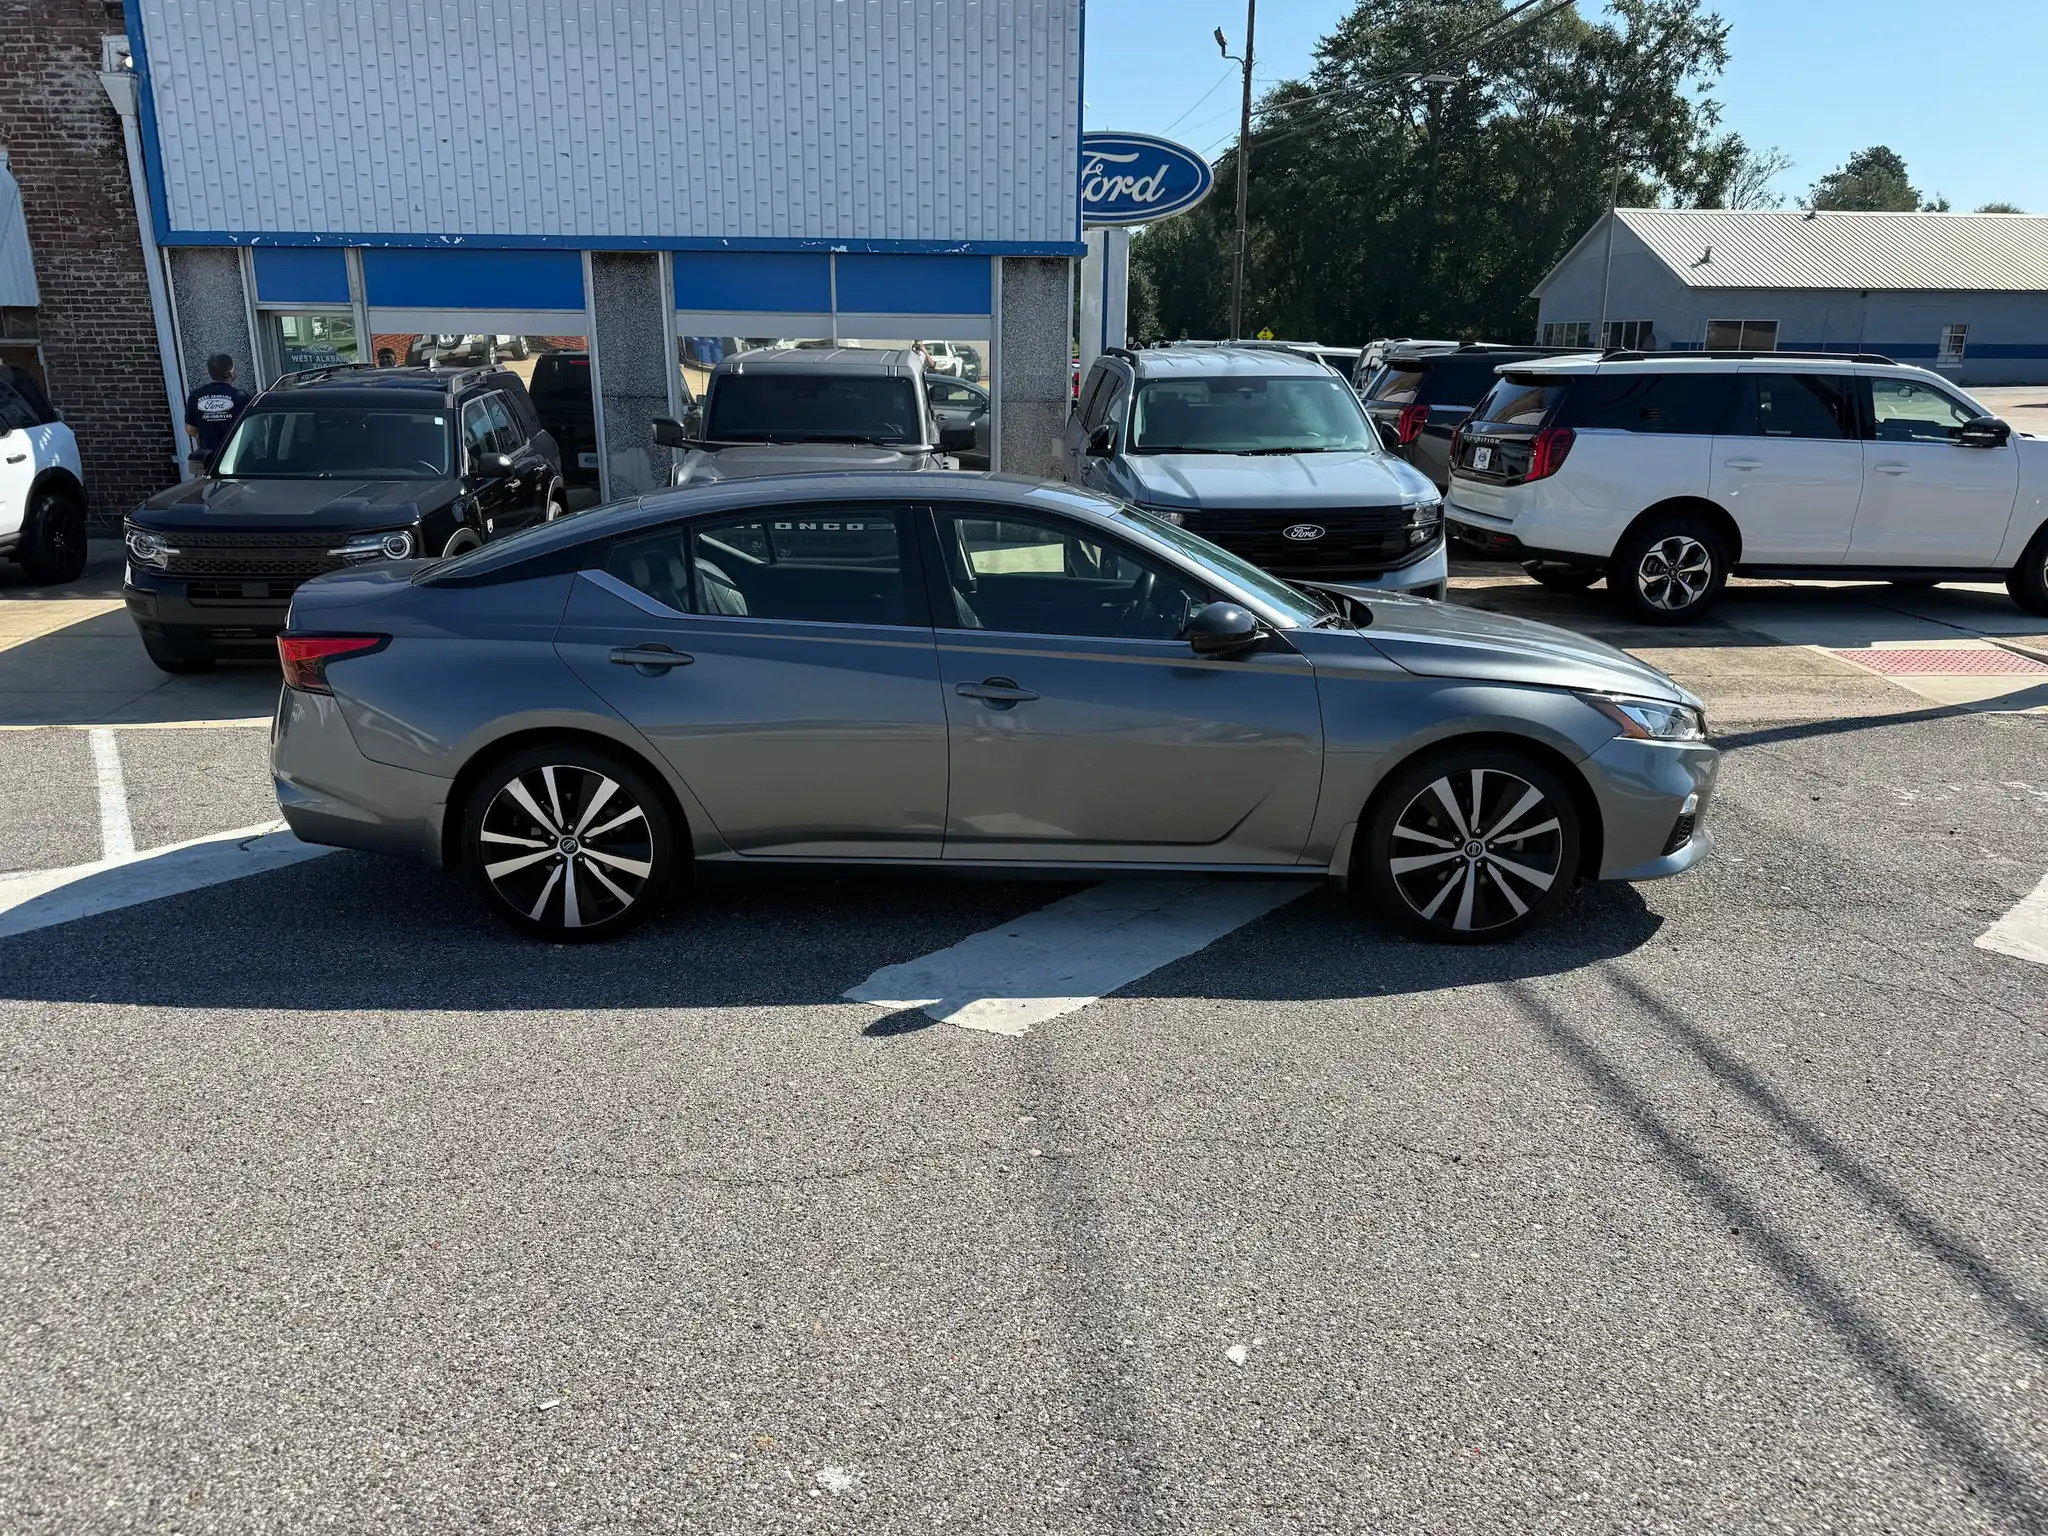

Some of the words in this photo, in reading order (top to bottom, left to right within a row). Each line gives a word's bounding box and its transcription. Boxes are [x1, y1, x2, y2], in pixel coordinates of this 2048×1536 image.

[291, 354, 313, 362] WEST
[204, 400, 226, 410] Ford
[734, 522, 864, 530] ONCO
[1290, 526, 1318, 538] Ford
